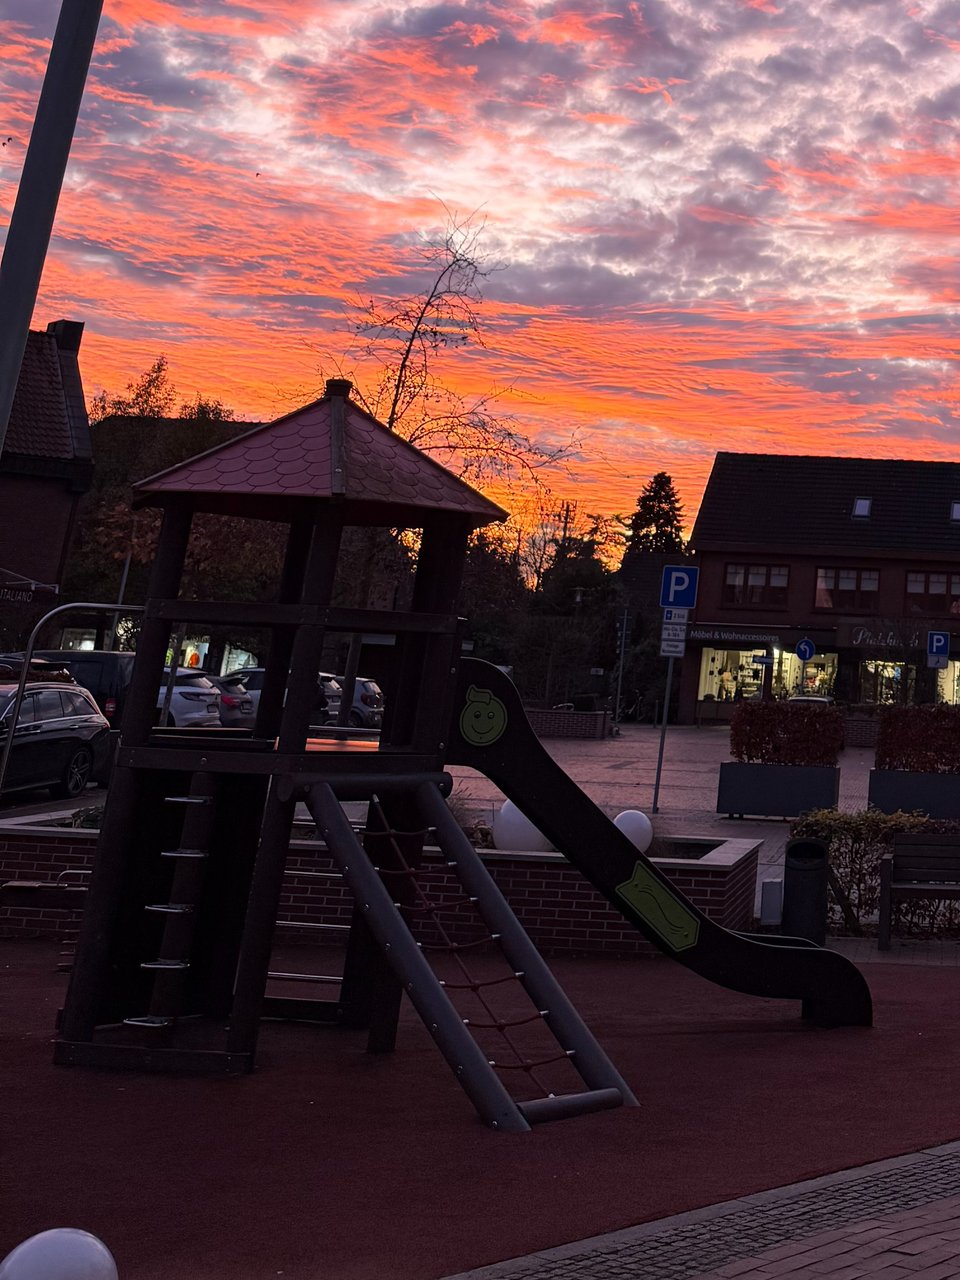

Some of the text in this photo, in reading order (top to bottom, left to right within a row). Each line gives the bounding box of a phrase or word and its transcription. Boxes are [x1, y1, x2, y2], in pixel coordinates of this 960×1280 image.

[668, 571, 690, 602] P
[690, 630, 712, 639] Möbel
[714, 631, 719, 639] &
[720, 631, 780, 642] Wohnaccessoires
[932, 635, 945, 653] P
